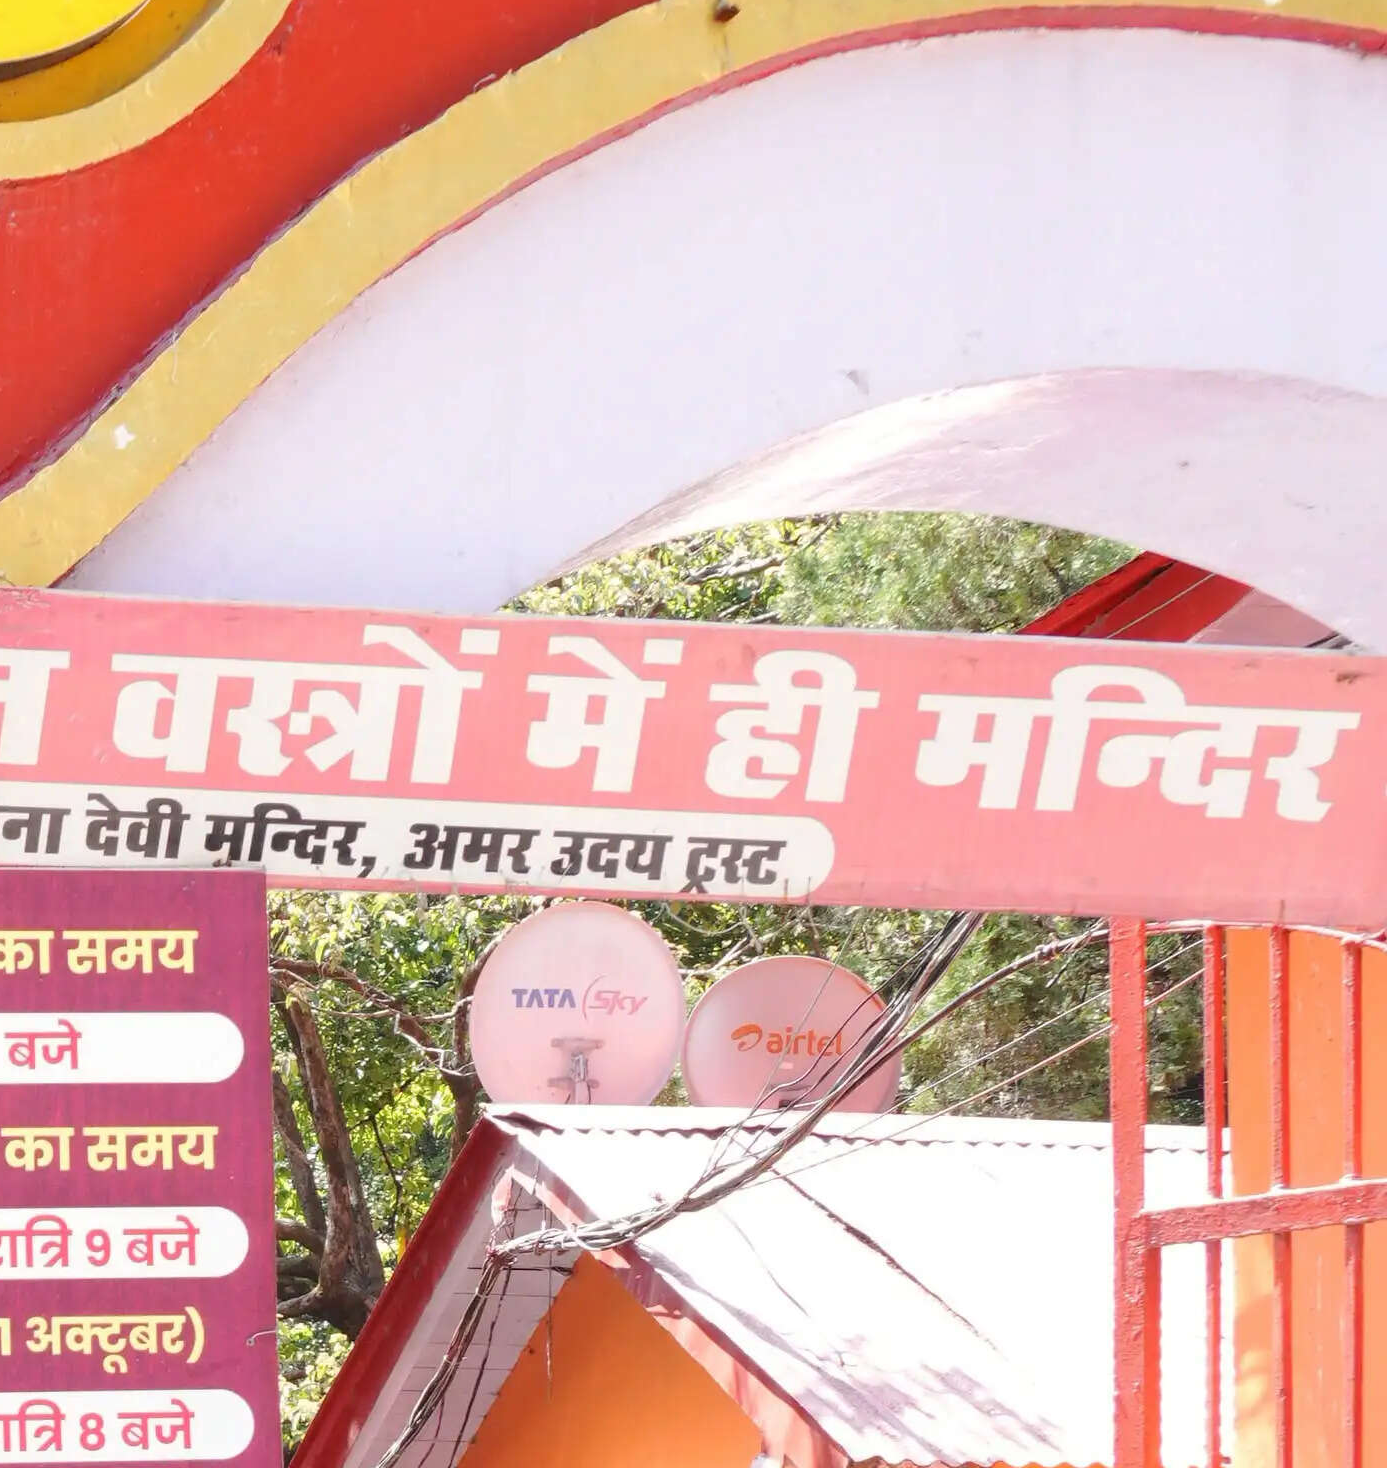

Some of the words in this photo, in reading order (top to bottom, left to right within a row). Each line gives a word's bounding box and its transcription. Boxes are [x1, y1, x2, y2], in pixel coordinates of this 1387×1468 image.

[111, 624, 498, 785] वस्त्रों
[527, 634, 684, 794] में
[704, 651, 876, 802] ही
[914, 664, 1361, 822] मन्दिर
[85, 792, 191, 860] देवी
[403, 821, 537, 875] अमर
[550, 828, 671, 881] उदय
[678, 834, 786, 894] ट्रस्ट
[64, 929, 198, 974] समय
[512, 988, 576, 1009] TATA
[588, 988, 648, 1016] Sky
[4, 1019, 82, 1071] बजे
[767, 1026, 843, 1057] airtel
[1, 1125, 74, 1172] का
[83, 1125, 219, 1171] समय
[86, 1228, 112, 1267] 9
[124, 1215, 200, 1266] बजे
[25, 1305, 206, 1374] अक्टूबर)
[79, 1412, 106, 1452] 8
[118, 1399, 194, 1450] बजे
